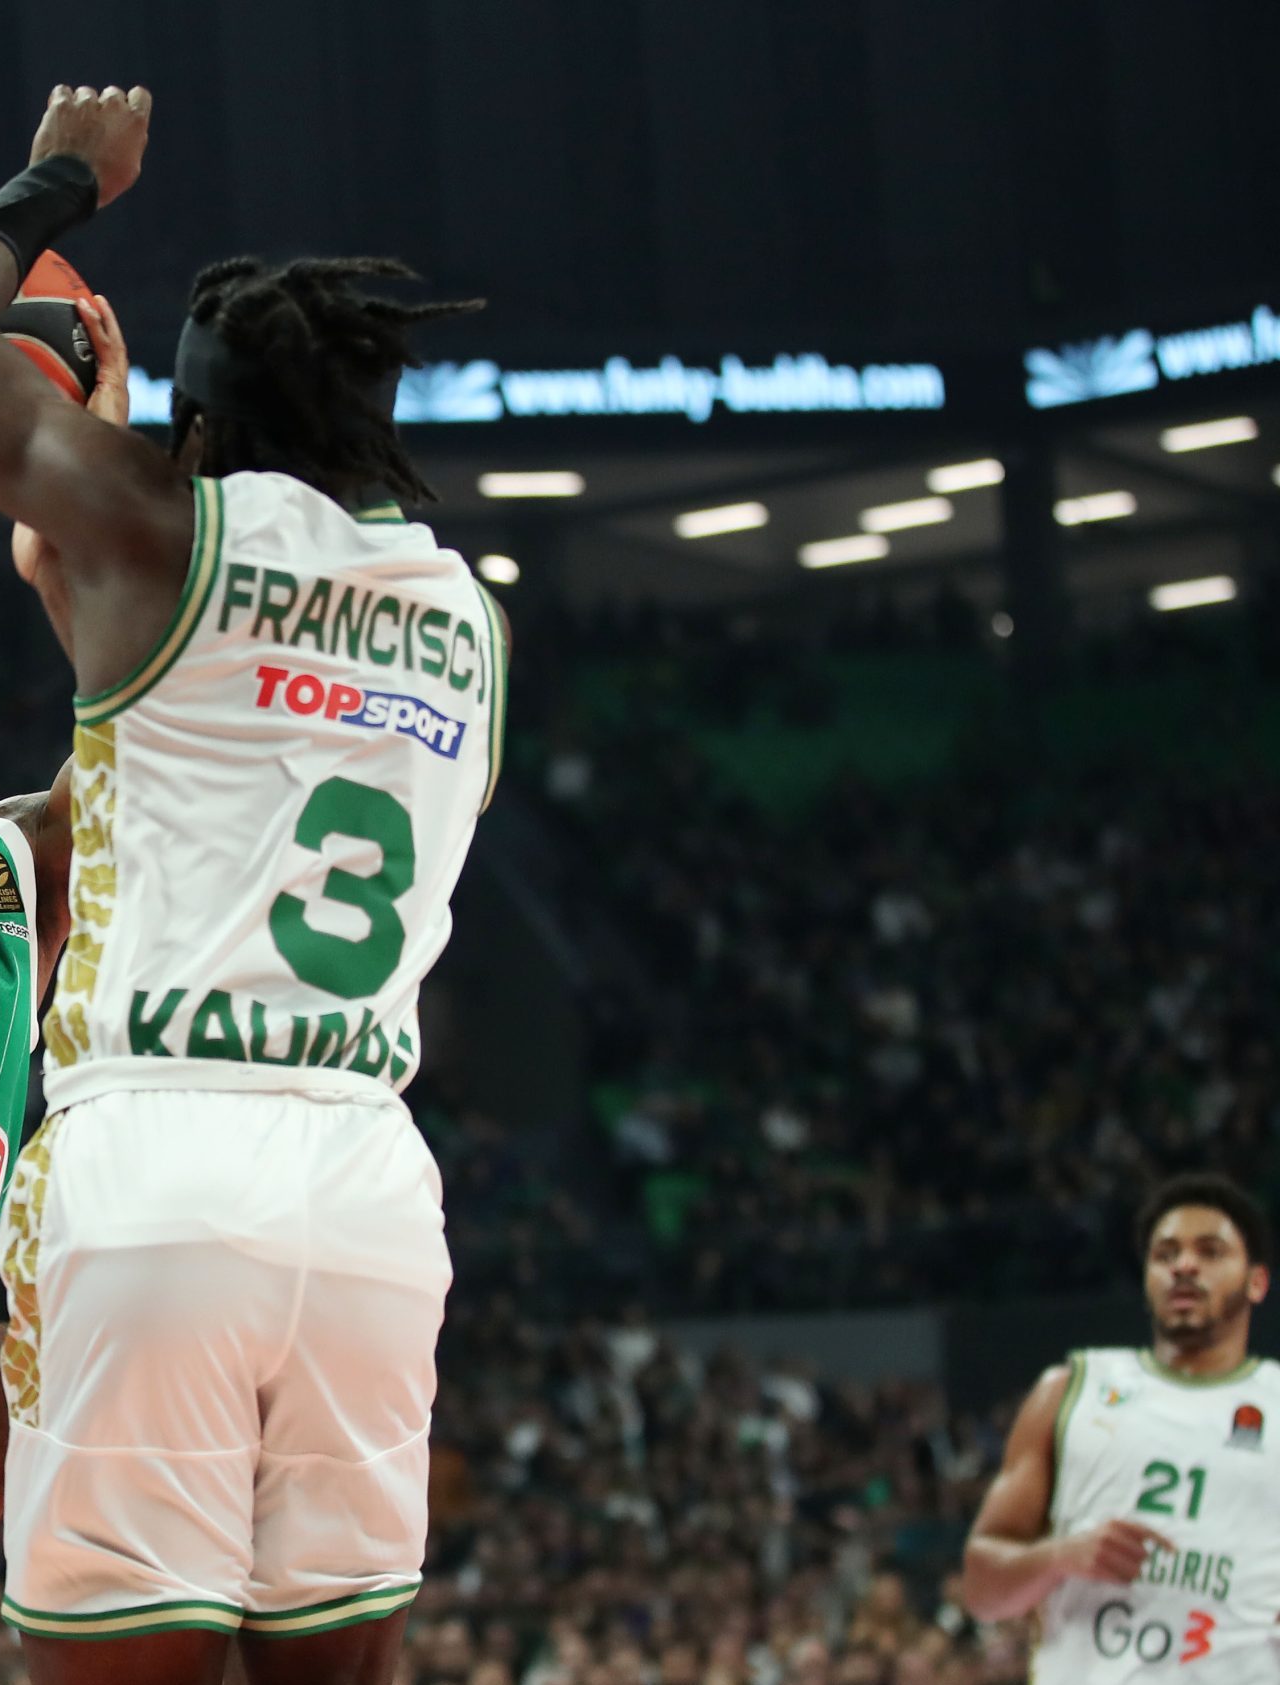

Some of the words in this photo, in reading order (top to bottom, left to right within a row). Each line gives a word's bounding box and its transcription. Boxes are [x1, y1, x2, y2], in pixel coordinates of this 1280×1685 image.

[217, 563, 485, 705] FRANCISC
[269, 776, 415, 1000] 3
[1137, 1461, 1206, 1519] 21
[1094, 1600, 1215, 1665] Go3
